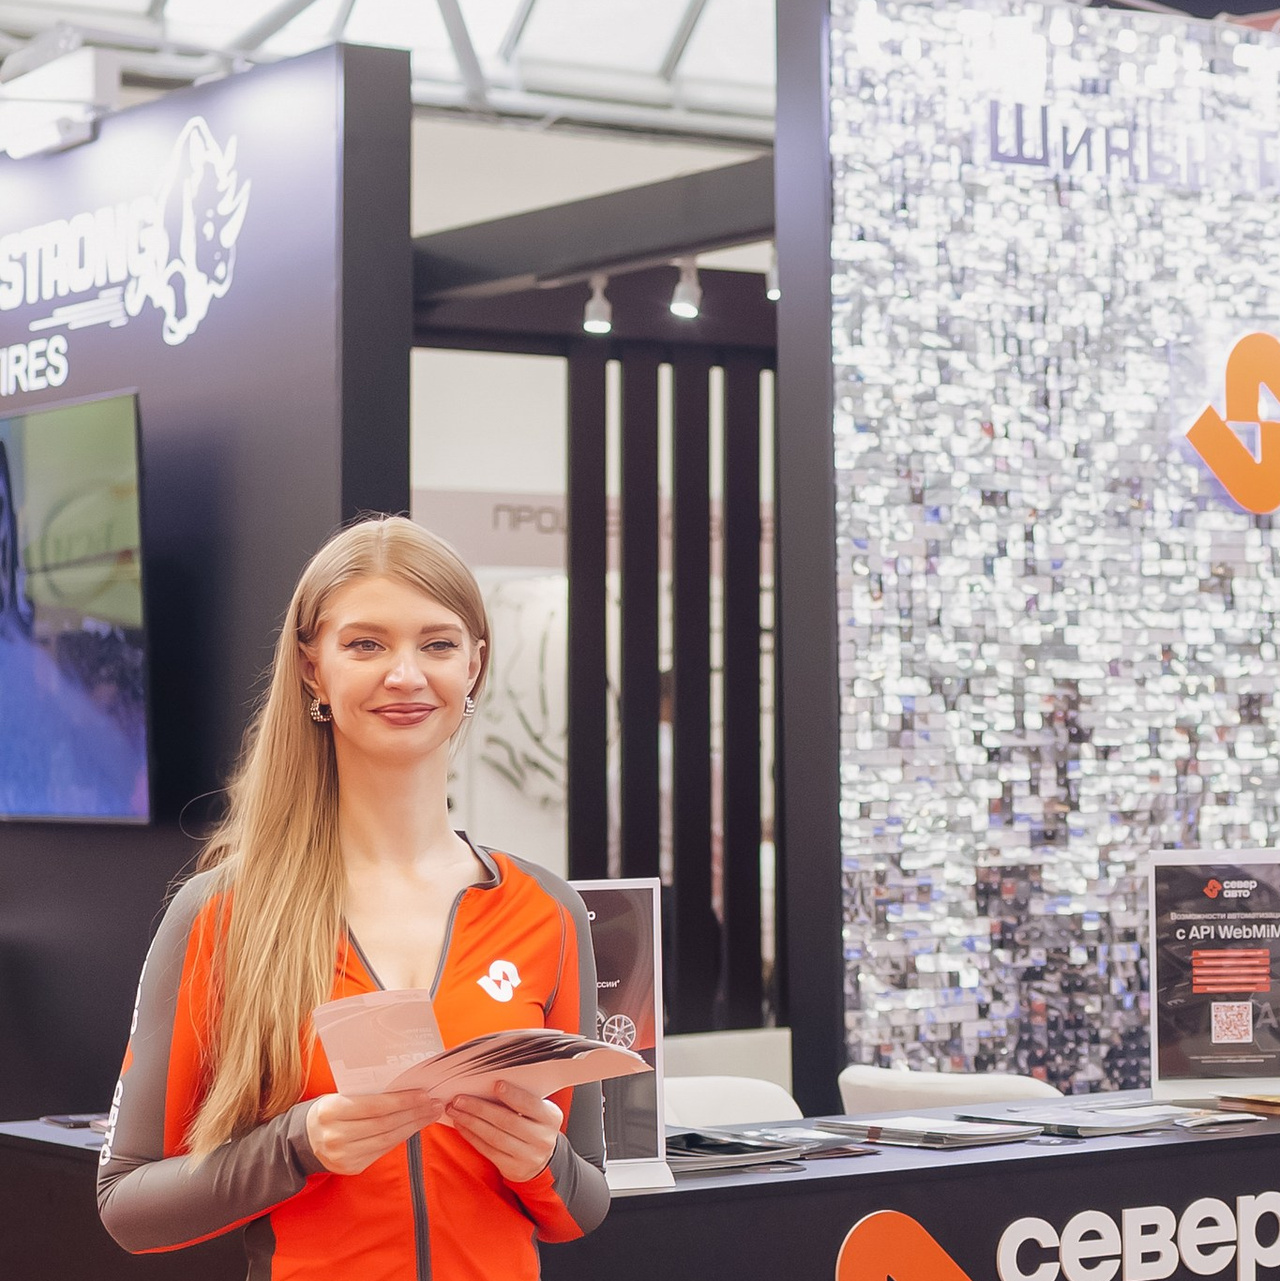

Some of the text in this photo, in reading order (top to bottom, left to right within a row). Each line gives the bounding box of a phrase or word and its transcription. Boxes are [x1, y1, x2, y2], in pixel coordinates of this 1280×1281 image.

[1223, 880, 1257, 890] север
[1223, 890, 1250, 898] авто
[1176, 929, 1186, 939] с
[1188, 926, 1214, 939] API
